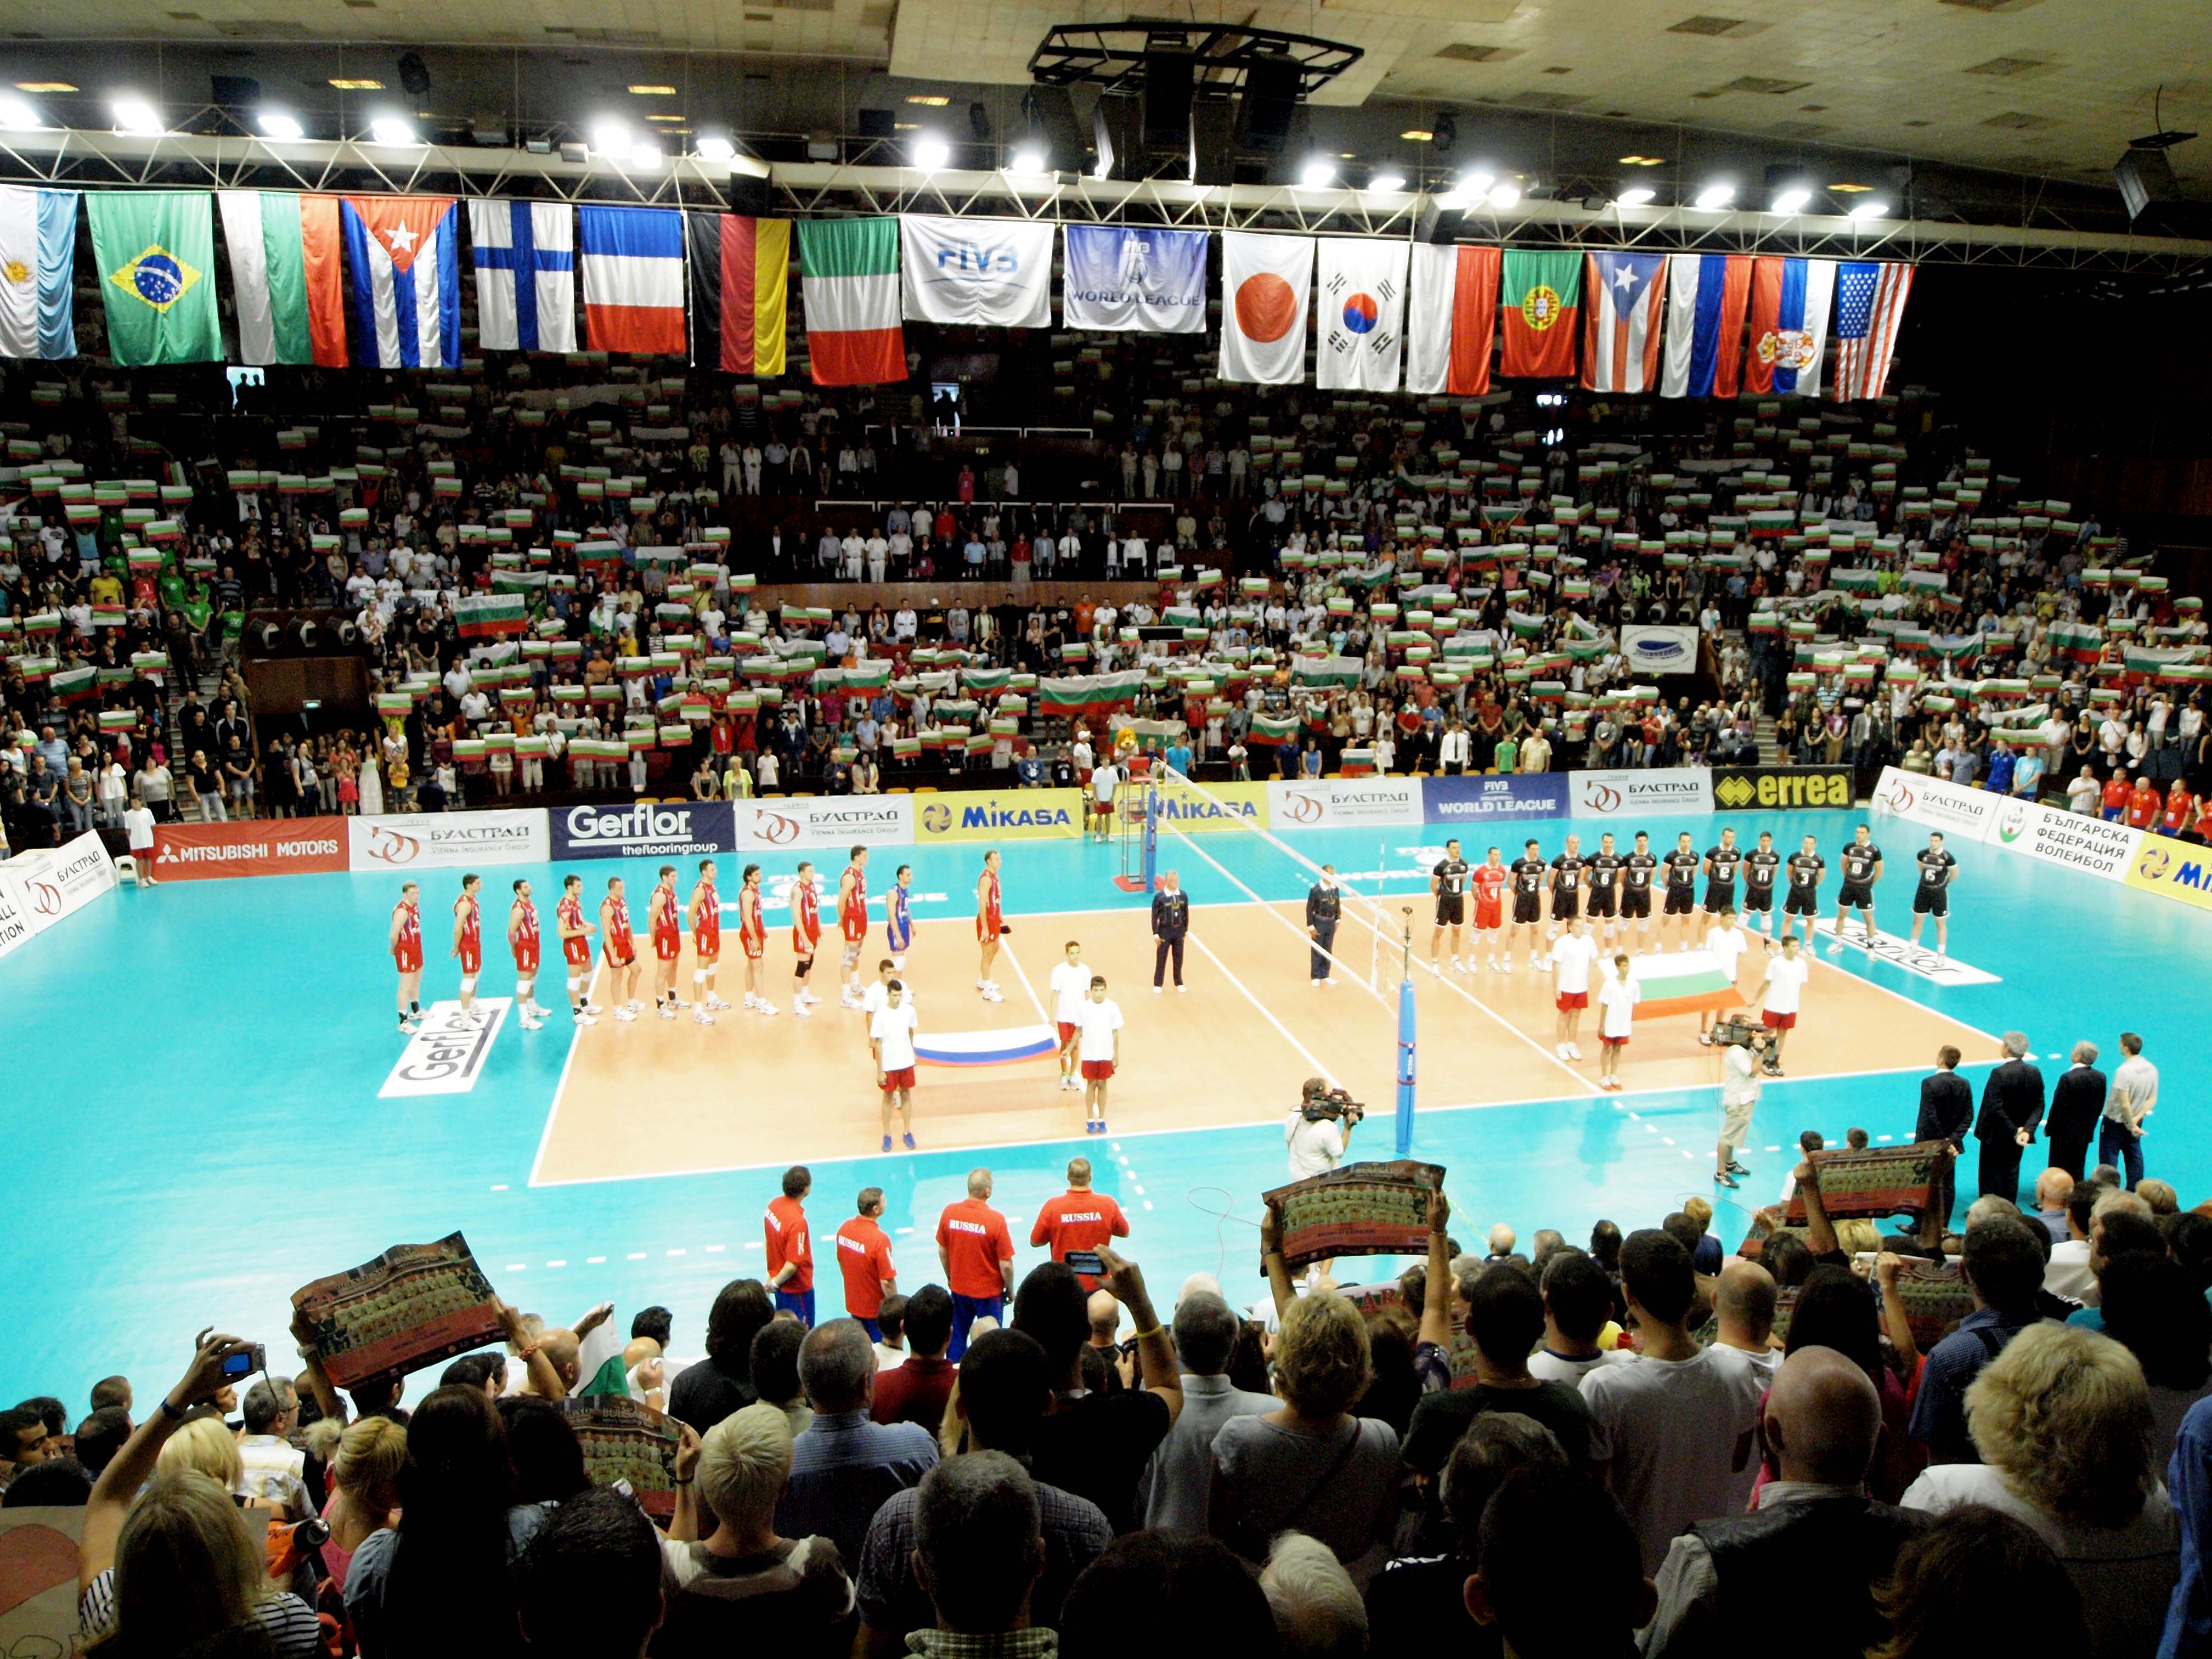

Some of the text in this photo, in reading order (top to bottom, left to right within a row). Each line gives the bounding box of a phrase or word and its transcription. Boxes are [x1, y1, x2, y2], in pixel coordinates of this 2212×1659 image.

[1073, 290, 1200, 306] WORLD LEAGUE
[1629, 782, 1699, 793] БУЛСТРАД
[1331, 793, 1408, 804] БУЛСТРАД
[1438, 799, 1556, 814] WORLD LEAGUE
[1922, 792, 1983, 815] БУЛСТРАД
[568, 804, 691, 838] Gerflor
[810, 810, 898, 823] БУЛСТРАД
[962, 799, 1071, 828] MIKASA
[431, 826, 529, 840] БУЛСТРАД
[2043, 812, 2130, 844] БЪЛГАРСКА
[180, 839, 338, 862] MITSUBISHI MOTORS
[2036, 828, 2126, 860] ФЕДЕРАЦИЯ
[2035, 843, 2114, 873] ВОЛЕЙБОЛ
[57, 851, 101, 882] БУЛСТРАД
[1601, 873, 1609, 885] 6
[1637, 872, 1644, 884] 9
[1062, 1212, 1102, 1223] RUSSIA
[950, 1219, 986, 1234] RUSSIA
[838, 1235, 865, 1254] RUSSIA
